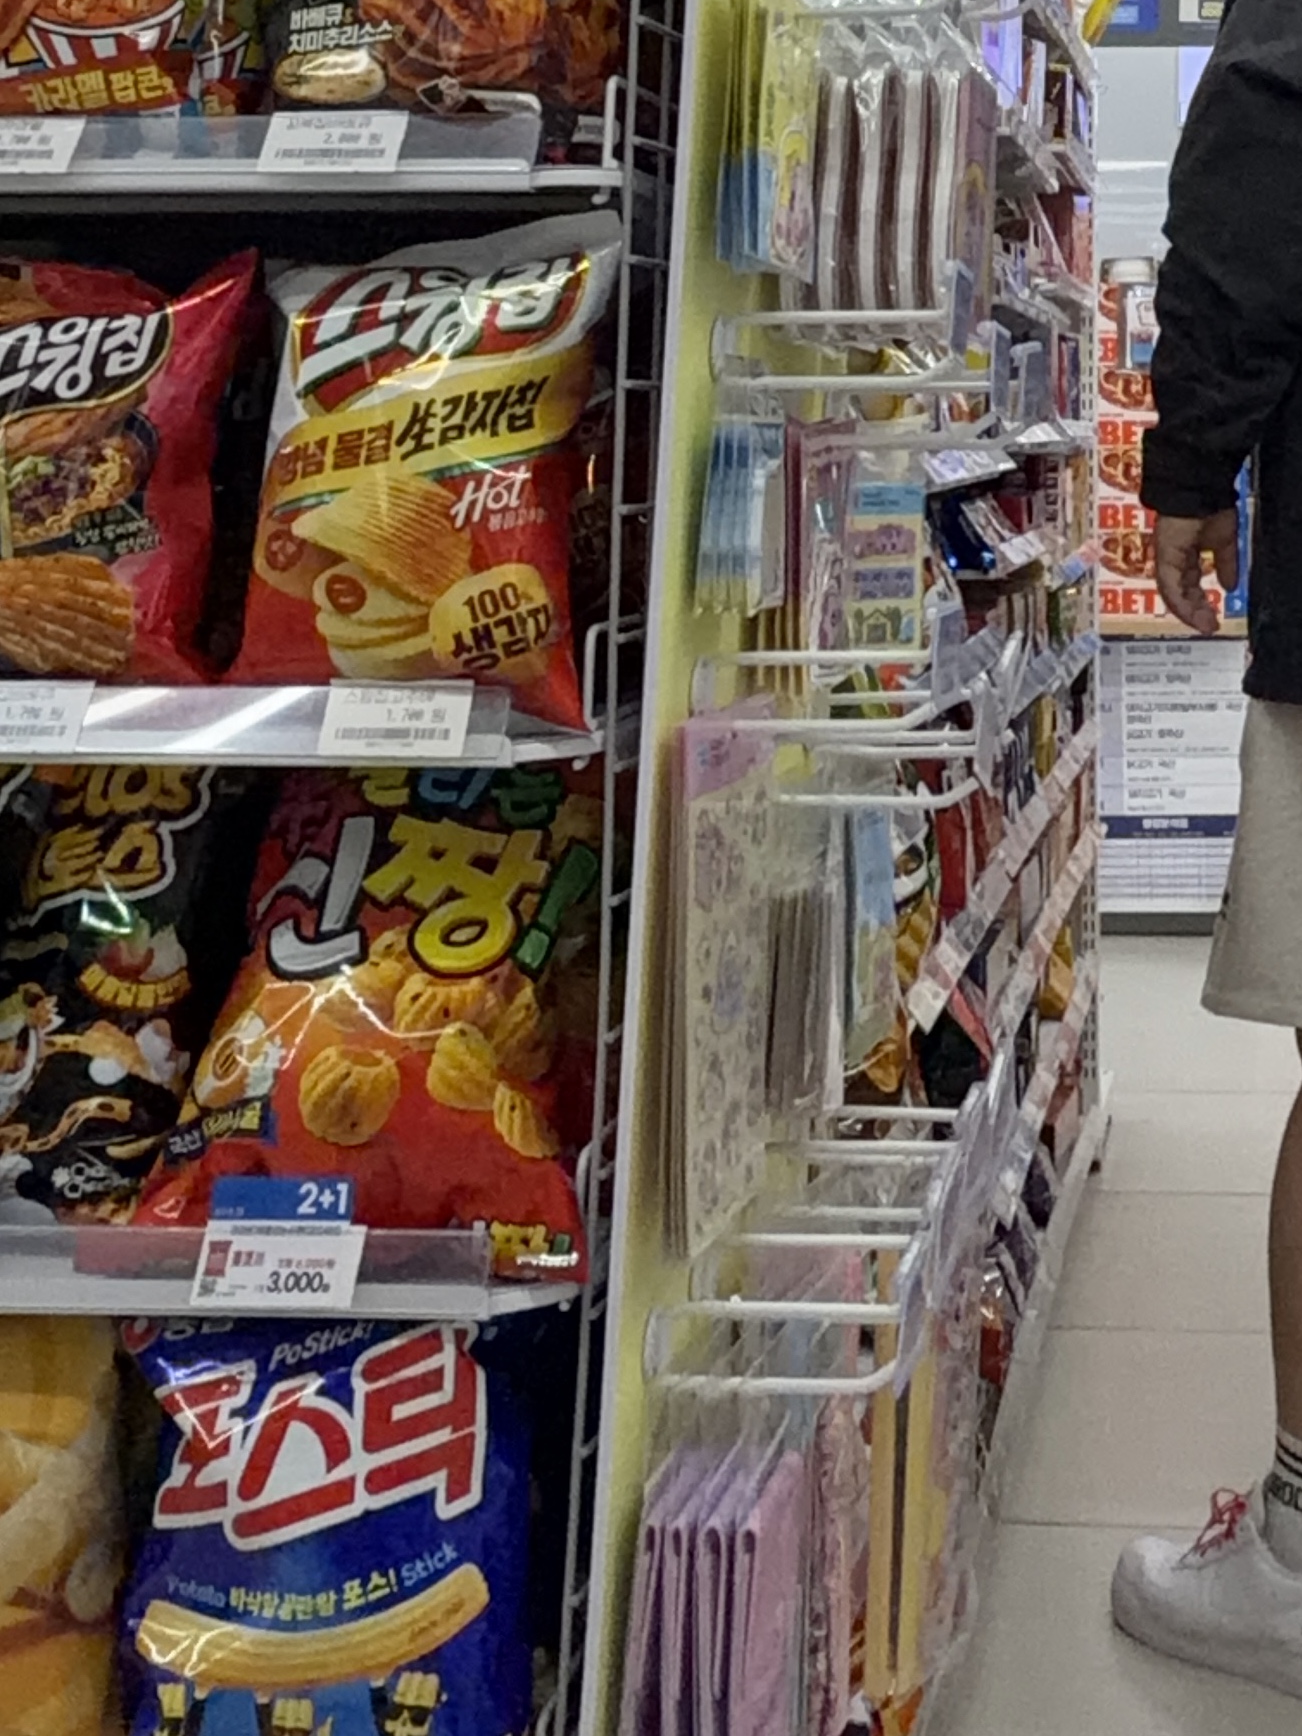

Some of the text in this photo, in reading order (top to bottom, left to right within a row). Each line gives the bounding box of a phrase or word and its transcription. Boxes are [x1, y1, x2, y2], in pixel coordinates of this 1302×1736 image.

[297, 257, 574, 396] 스윙칩
[451, 469, 532, 528] Hot
[297, 1181, 349, 1216] 2+1
[155, 1321, 487, 1551] 포스틱
[400, 1542, 459, 1588] Stick
